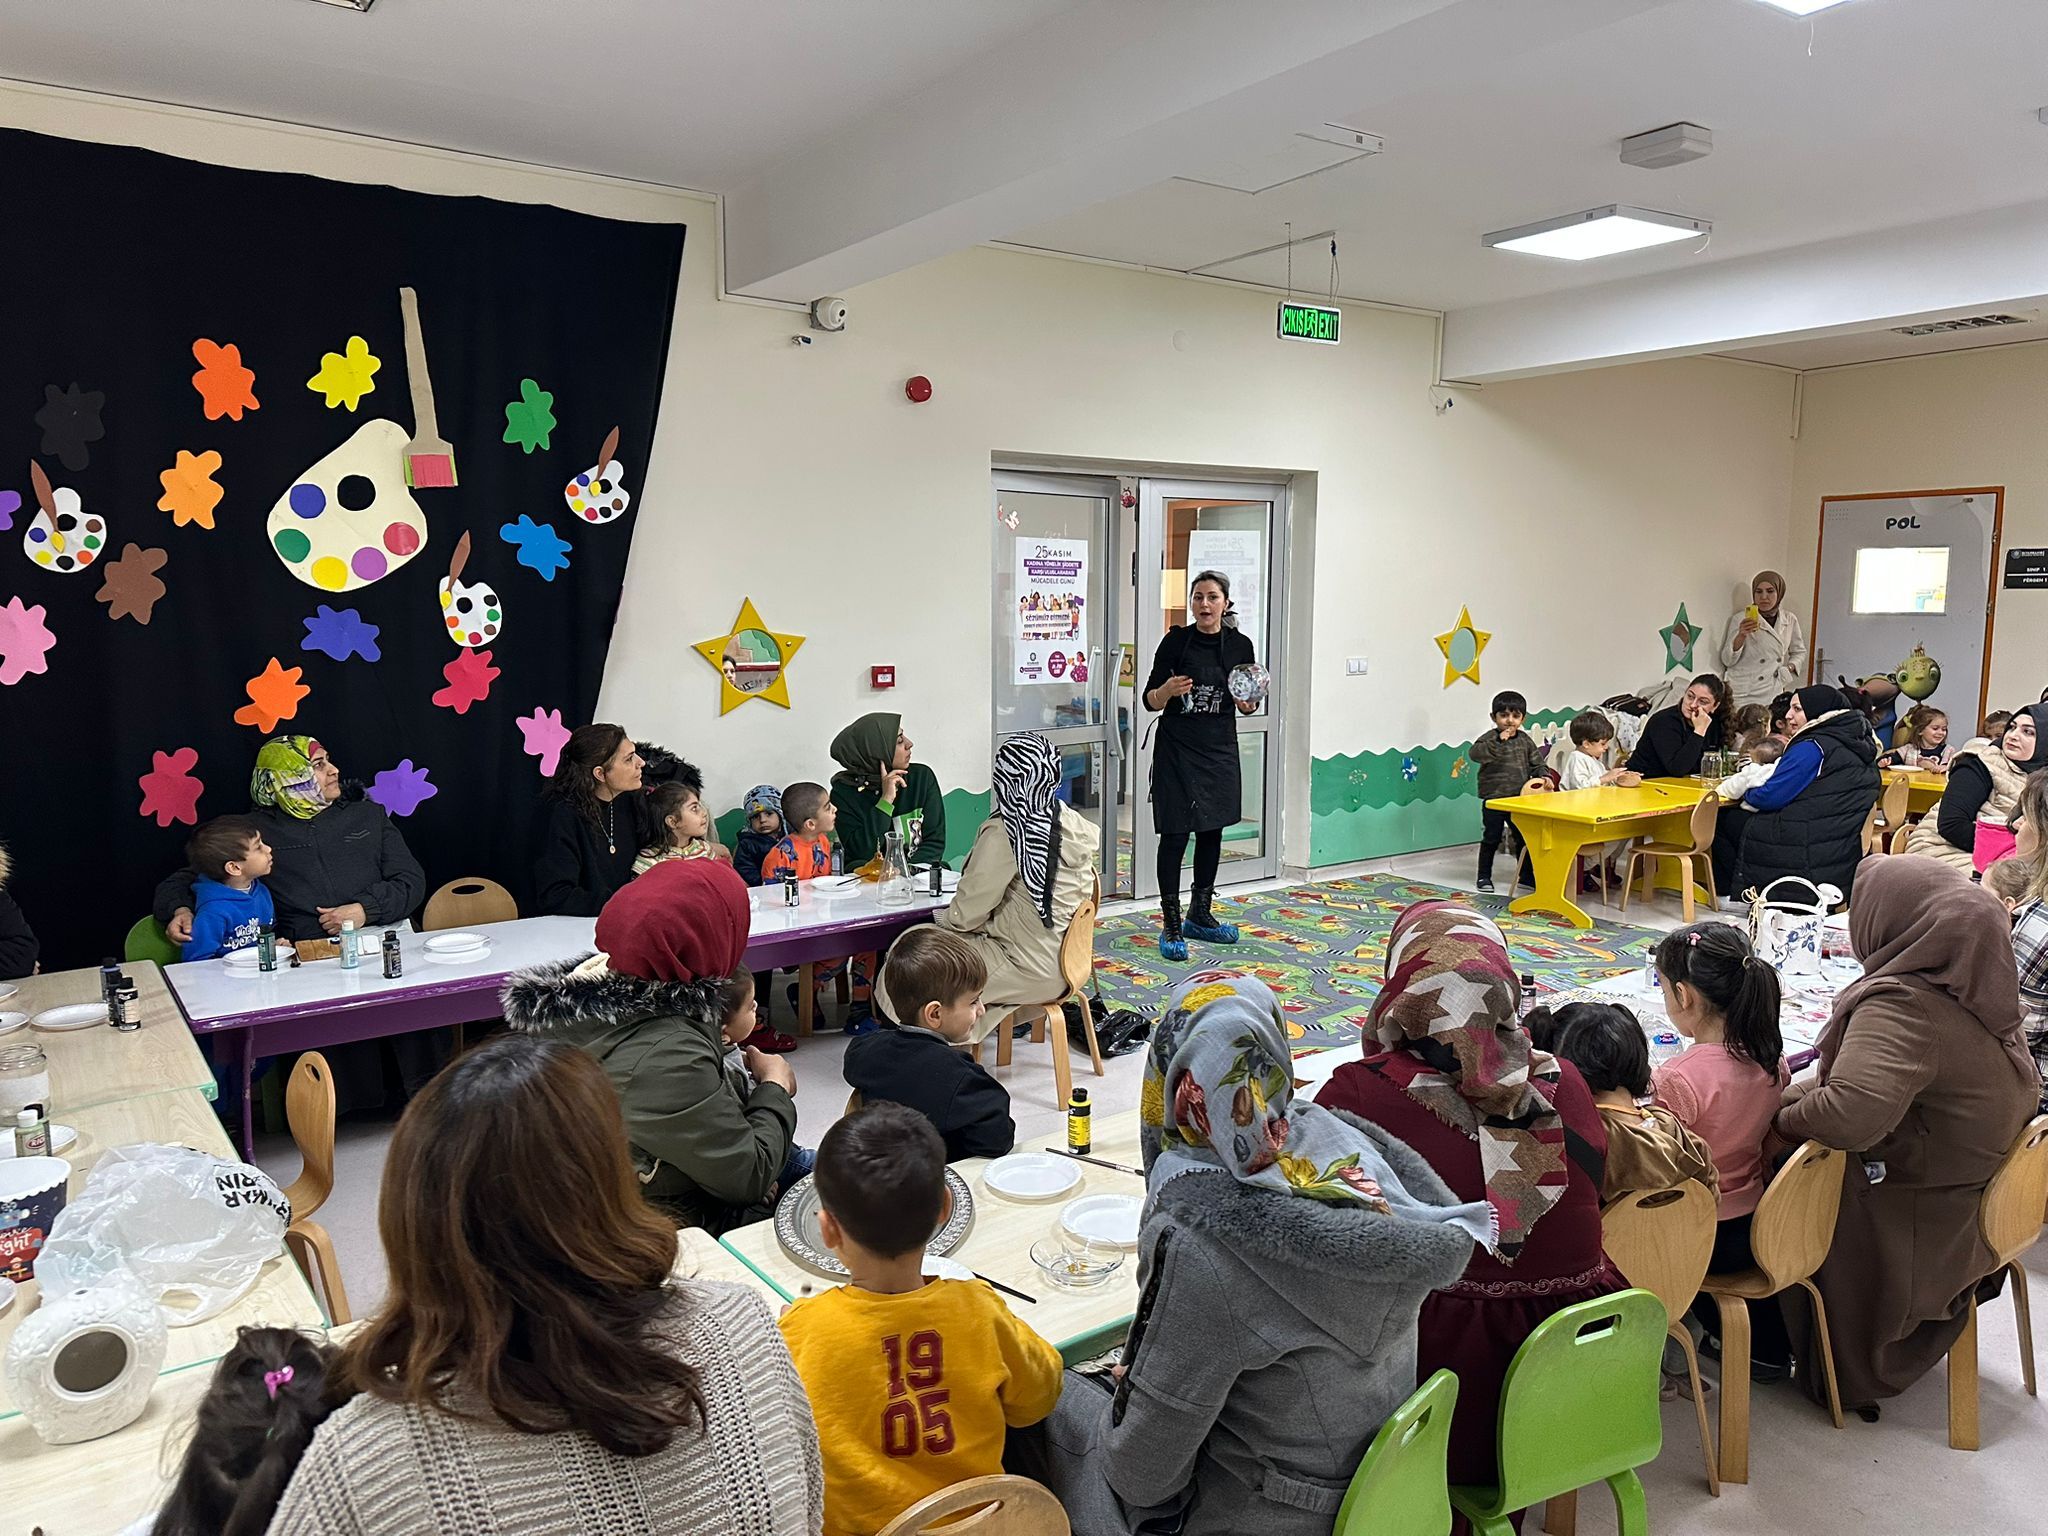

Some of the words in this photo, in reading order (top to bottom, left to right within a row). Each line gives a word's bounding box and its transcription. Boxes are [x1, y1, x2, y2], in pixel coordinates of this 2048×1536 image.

[1318, 312, 1338, 340] EXIT
[1886, 516, 1921, 530] POL
[1035, 545, 1049, 558] 25
[0, 1233, 32, 1257] ight
[881, 1330, 944, 1399] 19
[881, 1389, 956, 1459] 05
